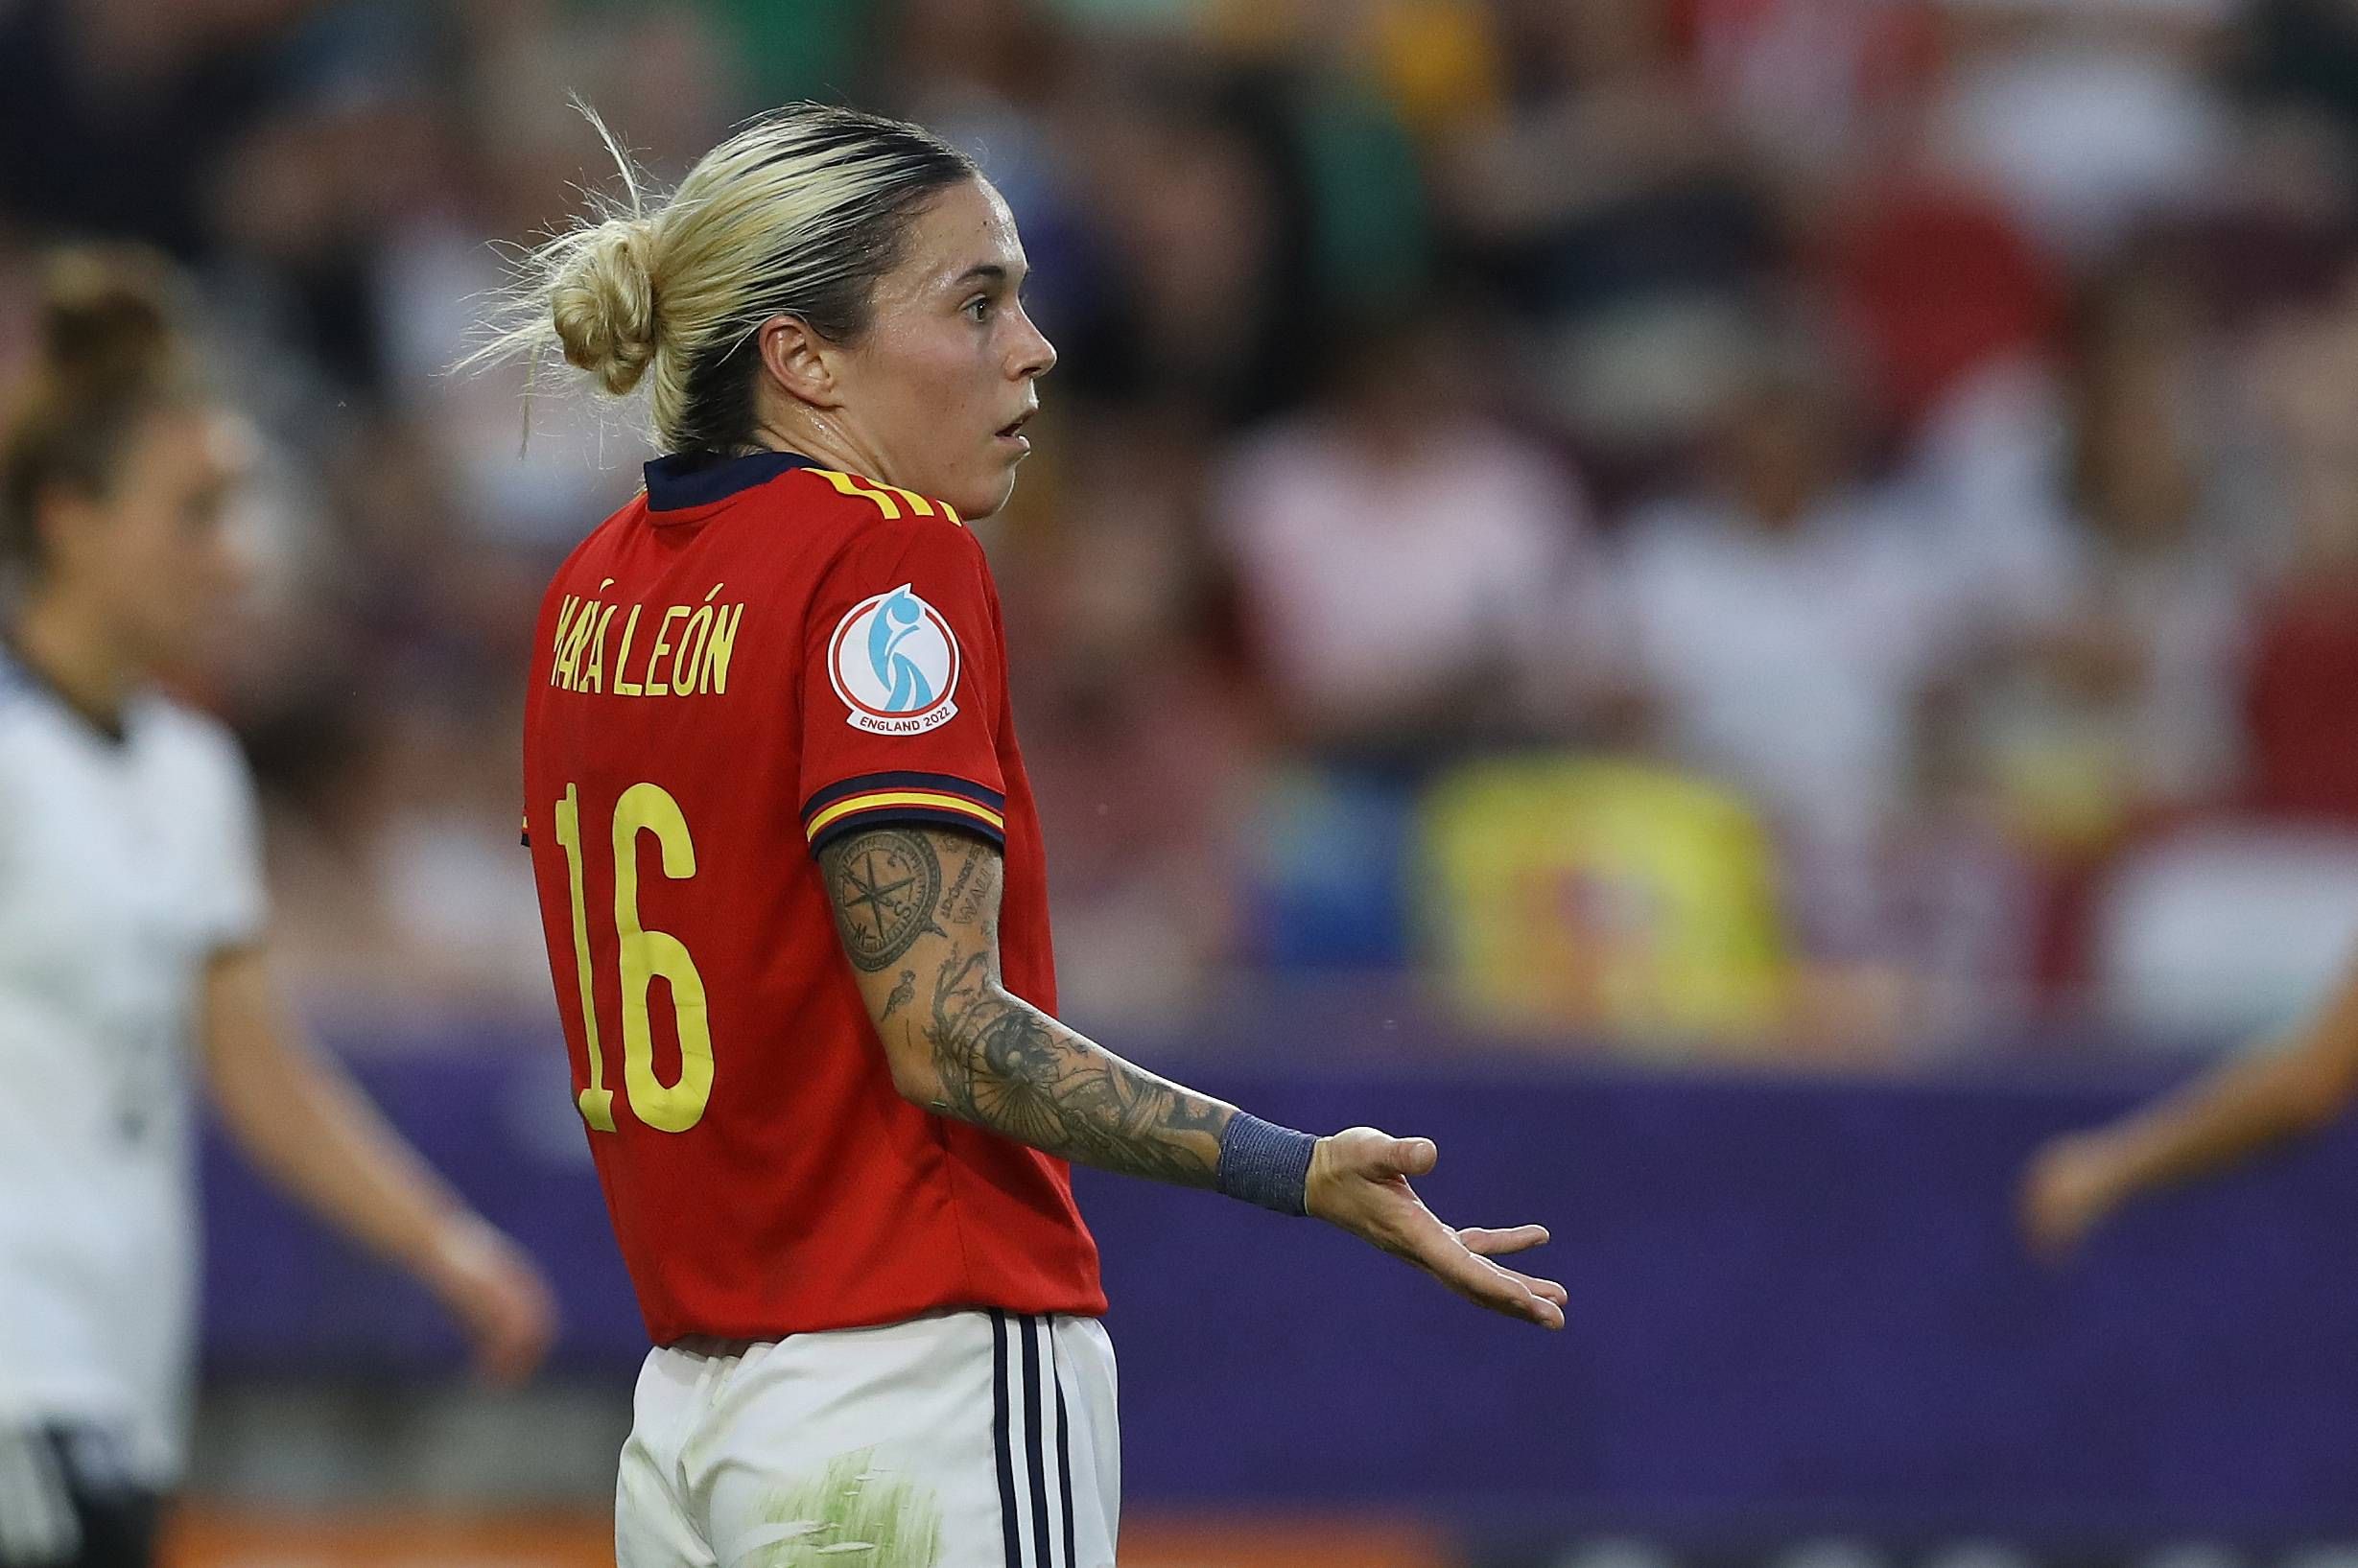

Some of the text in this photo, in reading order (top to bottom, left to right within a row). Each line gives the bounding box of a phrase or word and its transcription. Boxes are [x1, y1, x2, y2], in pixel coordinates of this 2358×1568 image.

[613, 583, 744, 697] LEÓN
[860, 707, 951, 732] ENGLAND 2022
[555, 783, 715, 1133] 16
